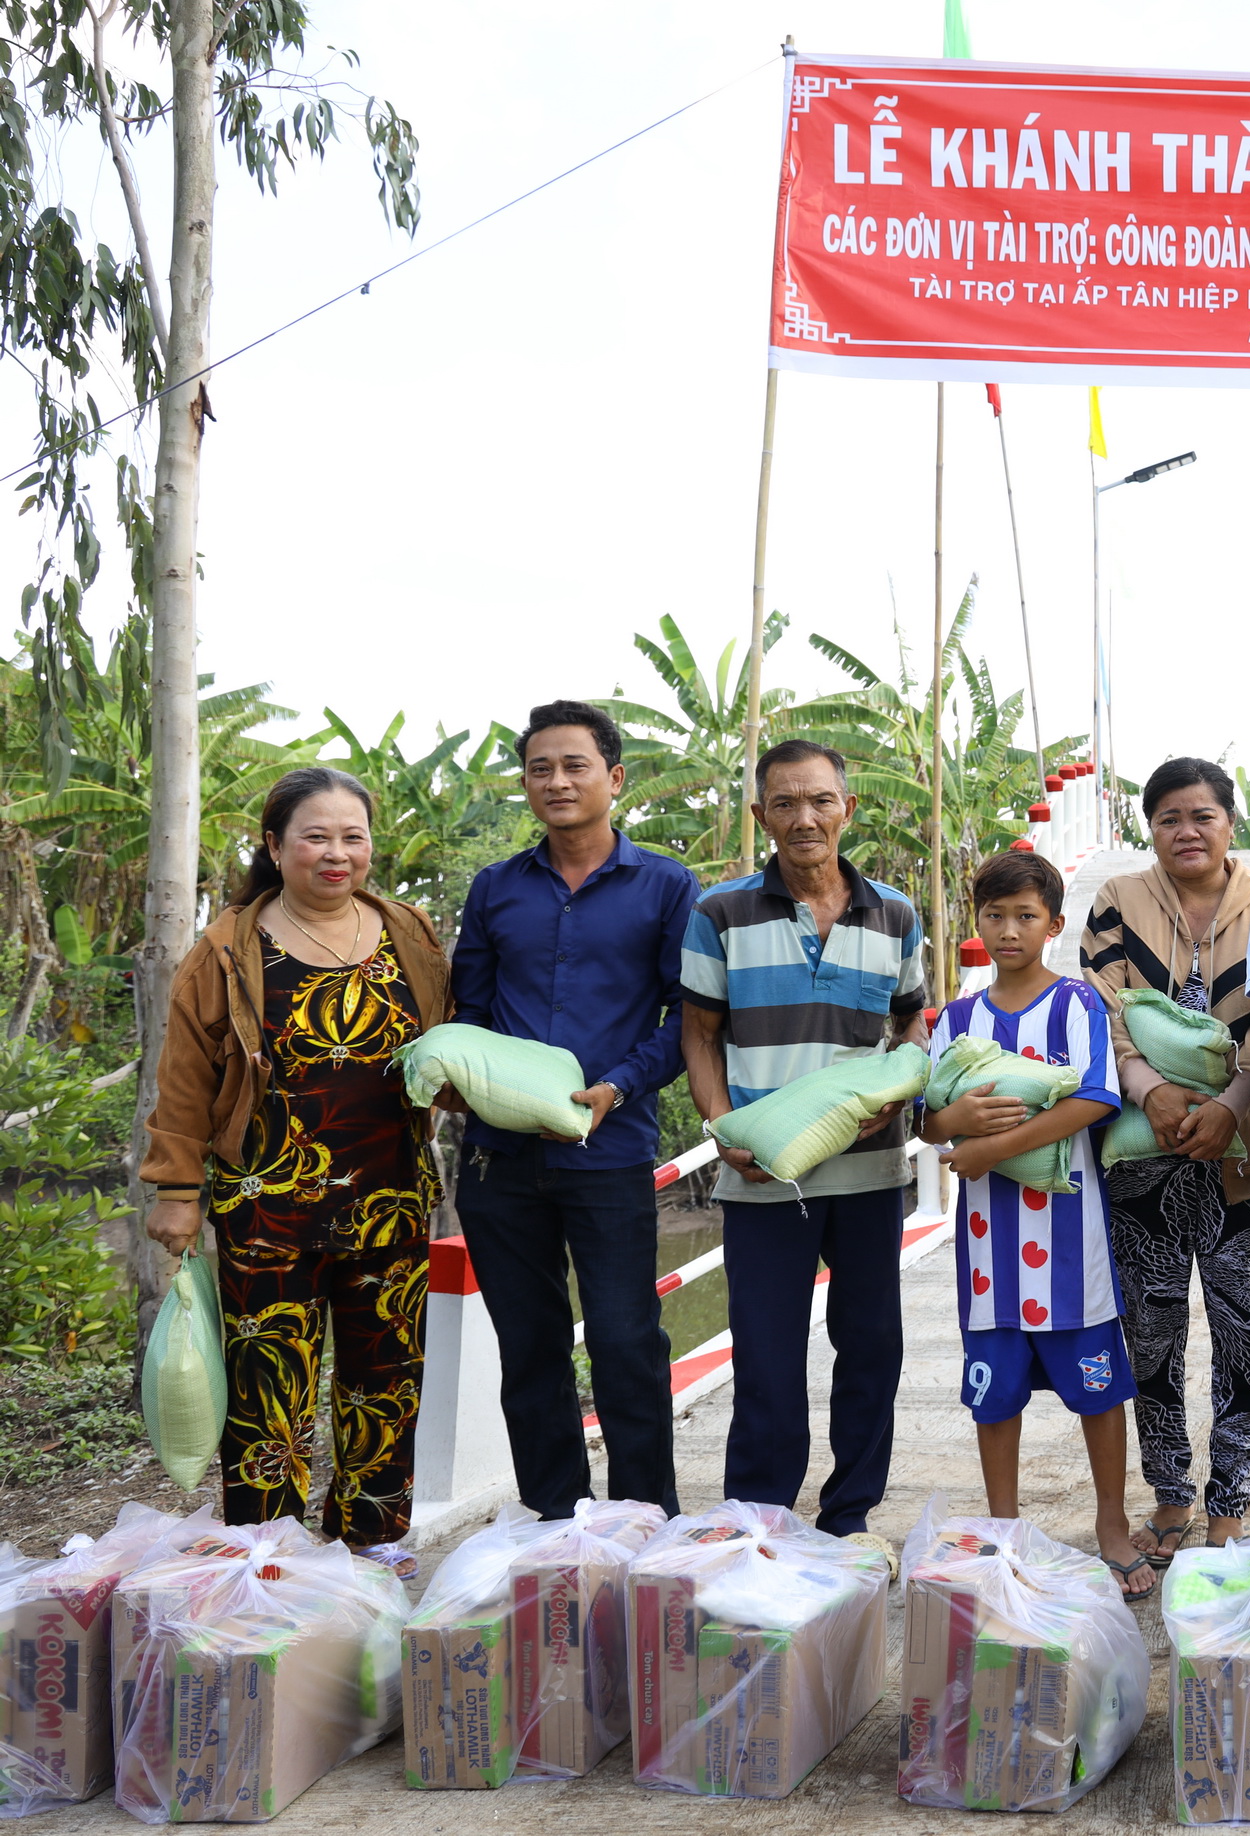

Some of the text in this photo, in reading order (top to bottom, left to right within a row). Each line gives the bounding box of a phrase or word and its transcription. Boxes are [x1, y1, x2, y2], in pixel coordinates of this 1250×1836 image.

[833, 95, 903, 186] LỄ
[930, 112, 1131, 192] KHÁNH
[822, 204, 878, 256] CÁC
[885, 211, 941, 260] ĐƠN
[948, 219, 975, 271] VỊ
[982, 210, 1027, 263] TÀI
[1034, 216, 1097, 274] TRỢ:
[1105, 213, 1177, 267] CÔNG
[908, 273, 952, 299] TÀI
[959, 279, 1015, 306] TRỢ
[1022, 282, 1065, 308] TẠI
[1072, 276, 1109, 305] ẤP
[1116, 280, 1169, 308] TÂN
[1178, 282, 1239, 314] HIỆP
[969, 1361, 992, 1406] 9
[410, 1636, 419, 1677] LOTHAMILK
[549, 1583, 569, 1665] KOKOMI
[667, 1590, 688, 1673] KOKOMI
[34, 1612, 66, 1740] KOKOMI
[522, 1665, 533, 1694] chua
[642, 1651, 654, 1726] Tôm chua cay
[180, 1702, 189, 1722] LONG
[190, 1674, 204, 1759] LOTHAMILK
[466, 1688, 480, 1769] LOTHAMILK
[480, 1722, 490, 1742] LONG
[1195, 1677, 1207, 1761] LOTHAMILK
[481, 1743, 491, 1768] THÀNH
[252, 1773, 260, 1815] LOTHAMILK
